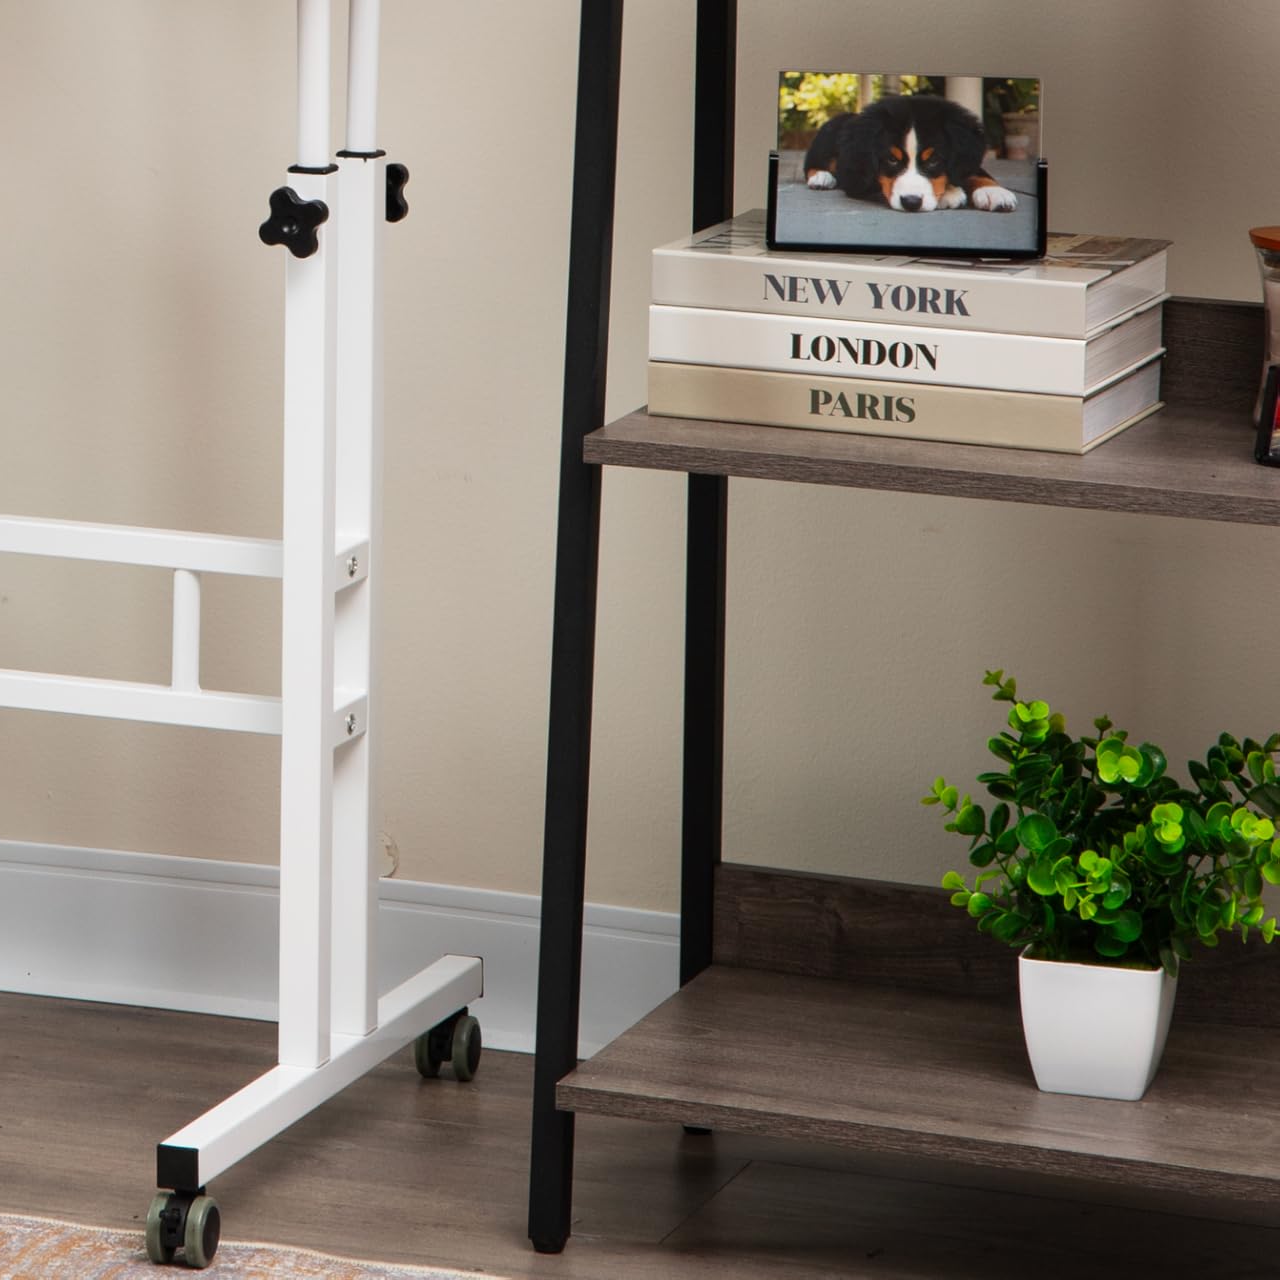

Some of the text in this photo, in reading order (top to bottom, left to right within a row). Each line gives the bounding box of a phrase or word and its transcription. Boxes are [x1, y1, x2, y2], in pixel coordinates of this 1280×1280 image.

[763, 274, 971, 317] NEW YORK
[790, 333, 939, 371] LONDON
[809, 388, 916, 424] PARIS
